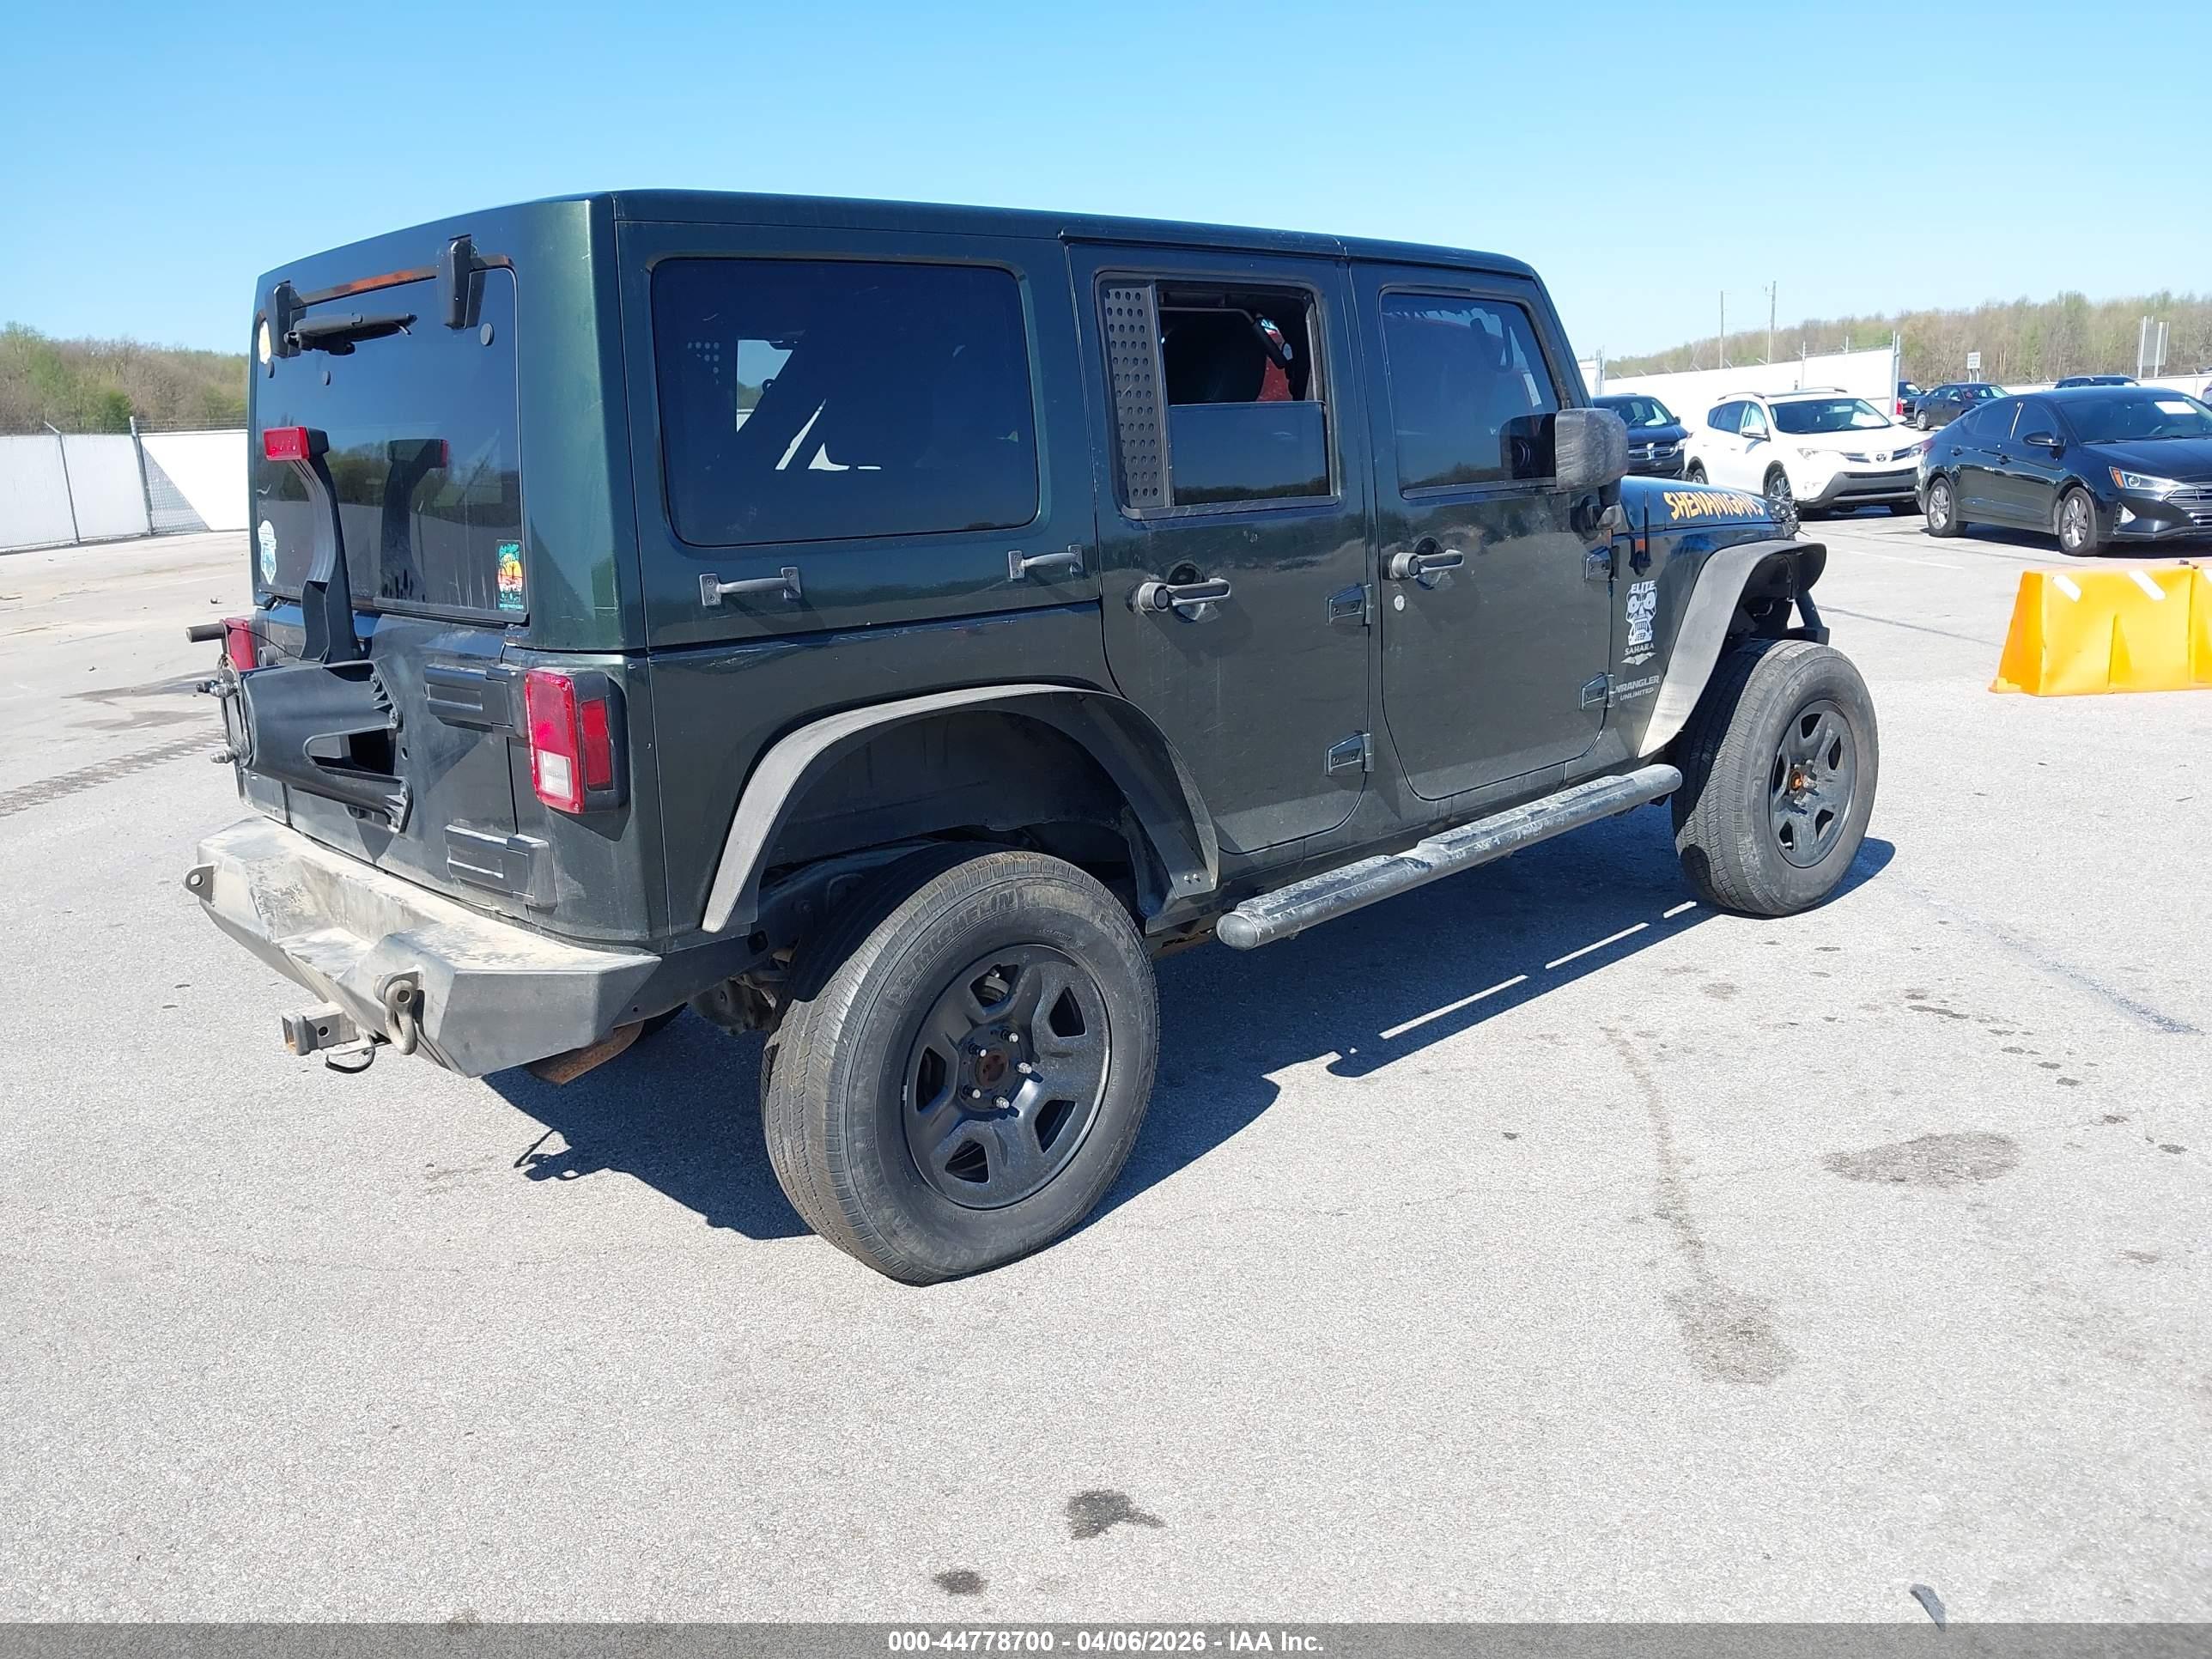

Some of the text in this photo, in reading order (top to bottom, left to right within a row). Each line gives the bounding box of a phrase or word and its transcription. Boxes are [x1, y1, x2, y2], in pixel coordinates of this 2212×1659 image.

[1663, 491, 1764, 520] SHENANIGANS
[1631, 580, 1656, 594] ELITE
[1634, 632, 1646, 642] JEEP
[1625, 642, 1655, 656] SAHARA
[1620, 687, 1655, 701] UNLIMITED
[912, 889, 1017, 975] MICHELIN
